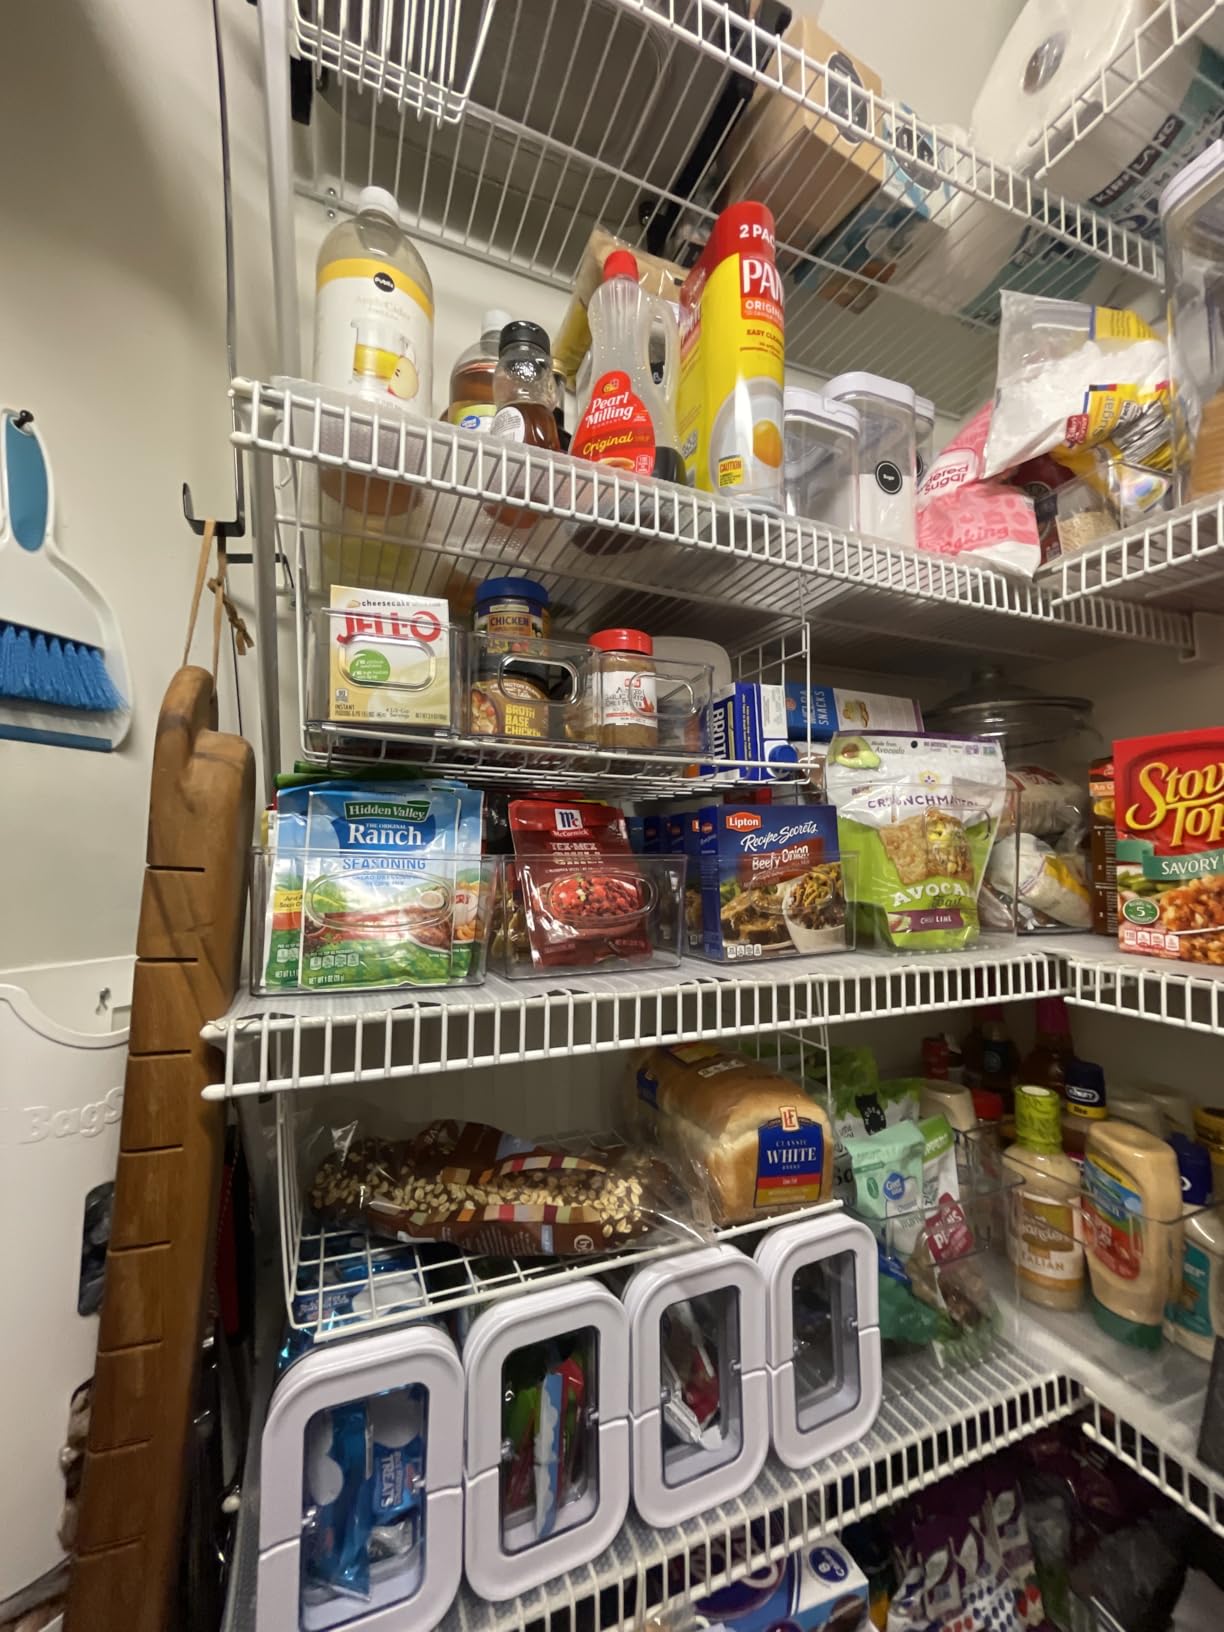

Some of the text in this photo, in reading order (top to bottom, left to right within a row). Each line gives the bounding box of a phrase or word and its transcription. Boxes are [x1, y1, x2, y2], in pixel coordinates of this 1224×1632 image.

[739, 224, 750, 239] 2
[591, 391, 629, 413] Pearl
[586, 406, 634, 428] Milling
[583, 431, 633, 456] Original
[923, 472, 967, 495] sugar
[489, 616, 530, 626] CHICKEN
[505, 703, 535, 719] BROTH
[815, 690, 830, 726] SNACKS
[504, 714, 529, 728] BASE
[349, 804, 426, 821] Hidden Valley
[729, 817, 759, 828] Lipton
[347, 823, 423, 846] Ranch
[552, 829, 590, 837] McCormick
[740, 820, 819, 852] Recipe Secrets
[343, 858, 426, 870] SEASONING
[752, 844, 809, 871] Beefy Onion
[1161, 855, 1219, 876] SAVORY
[889, 882, 970, 907] AVOCA
[1136, 906, 1146, 917] 5
[767, 1146, 817, 1164] WHITE
[380, 1453, 394, 1508] TREATS
